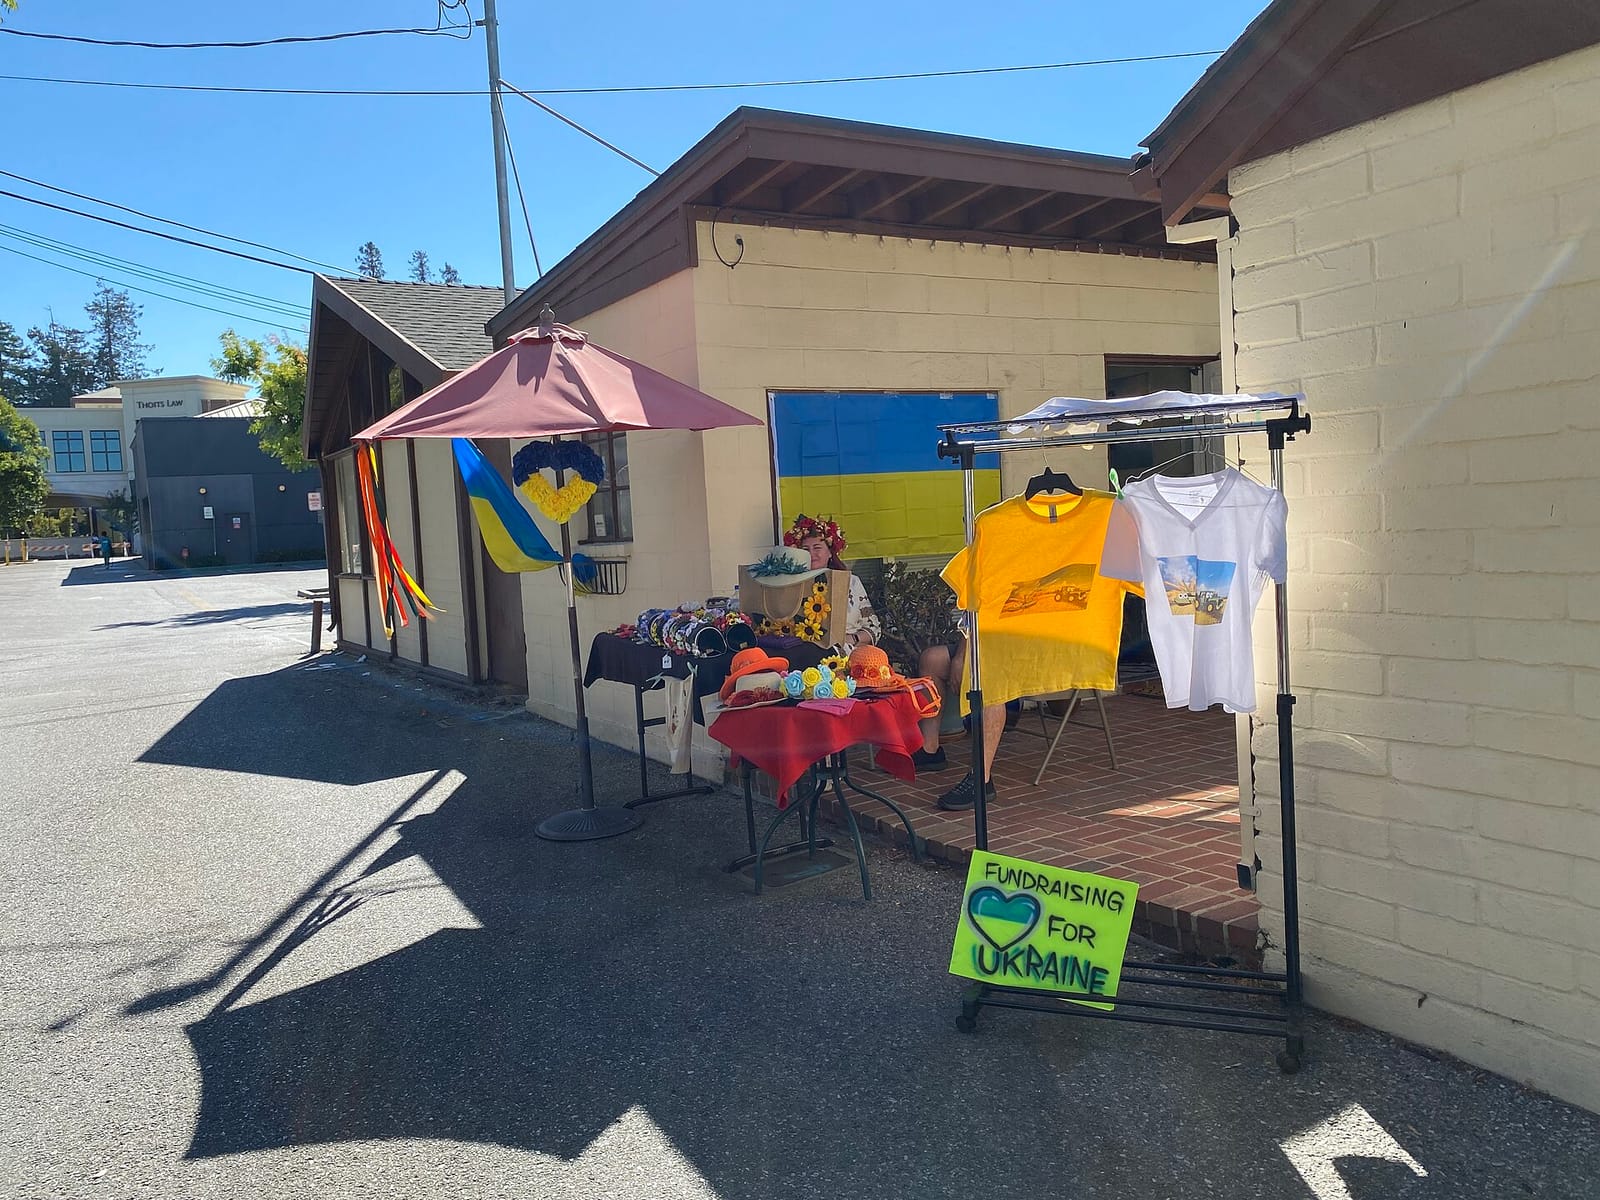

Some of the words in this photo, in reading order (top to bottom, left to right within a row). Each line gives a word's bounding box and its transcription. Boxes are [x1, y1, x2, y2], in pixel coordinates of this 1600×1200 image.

[166, 399, 184, 408] LAW
[985, 862, 1125, 915] FUNDRAISING
[1048, 914, 1096, 949] FOR
[974, 943, 1109, 995] UKRAINE
